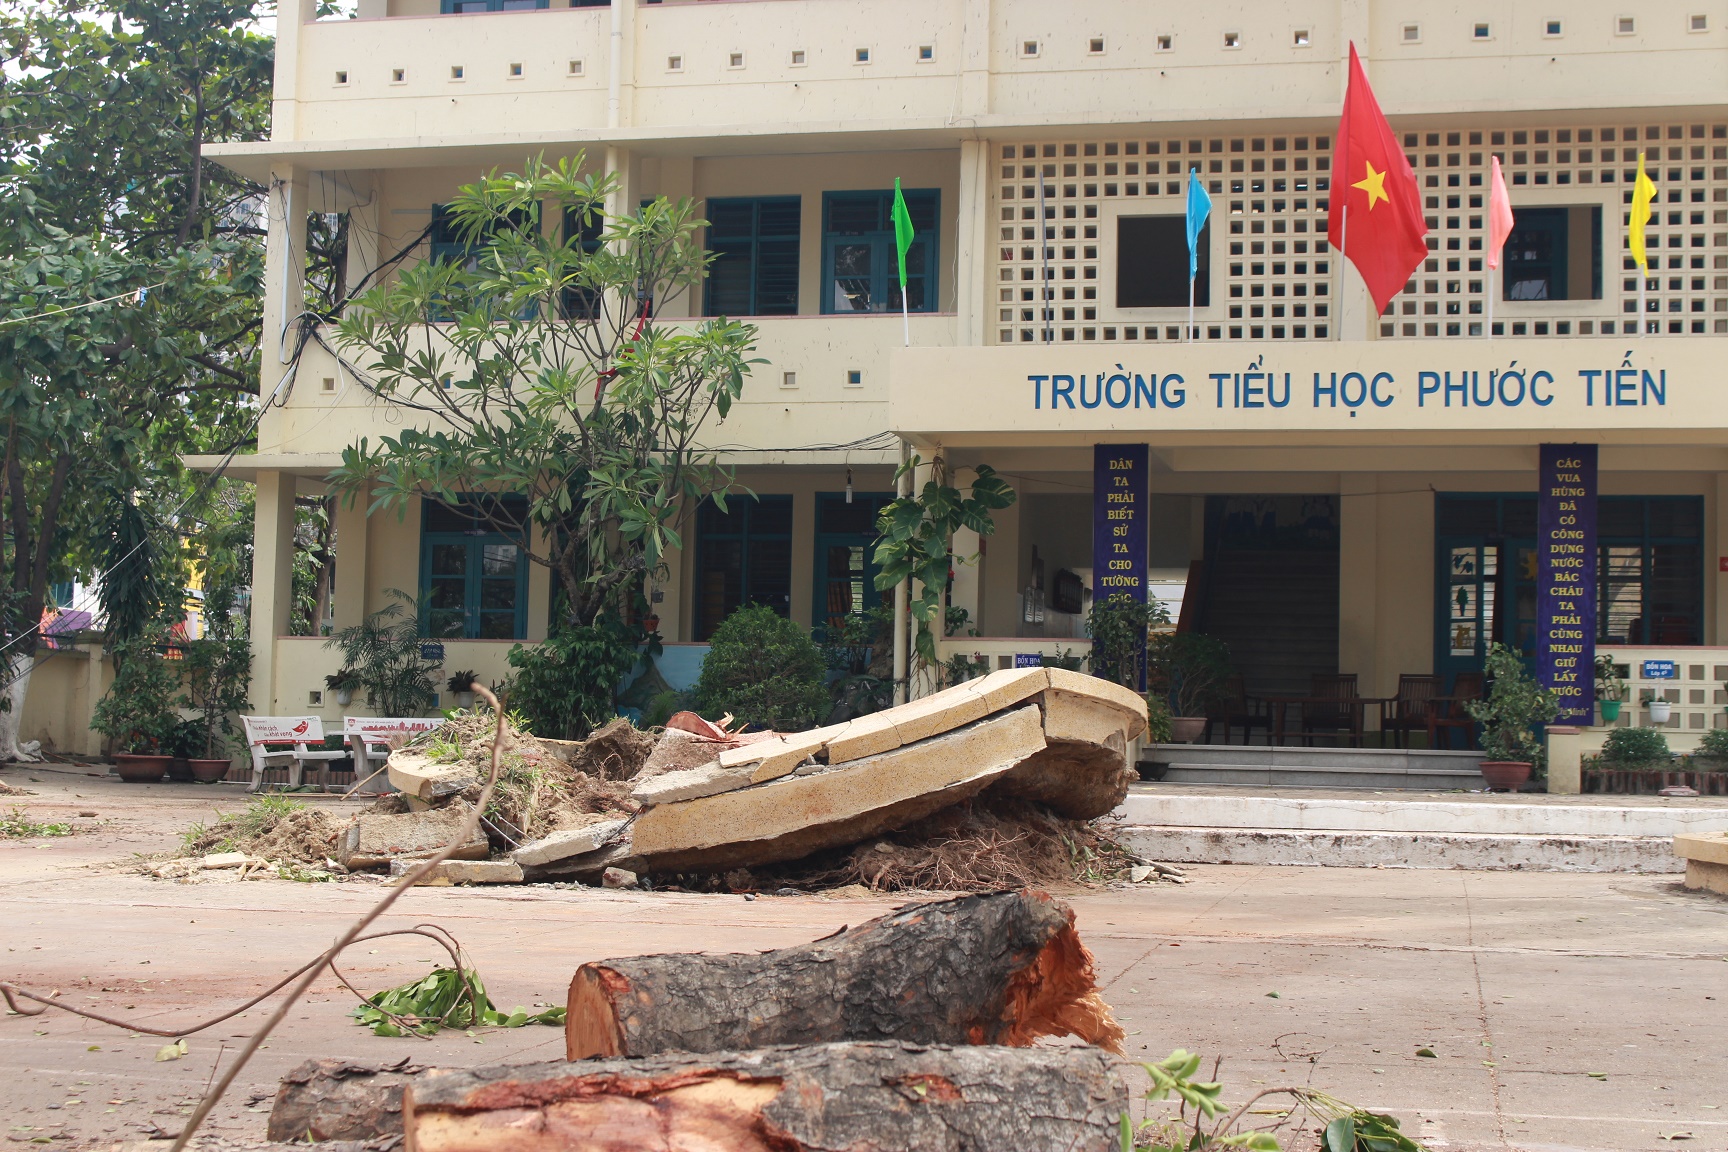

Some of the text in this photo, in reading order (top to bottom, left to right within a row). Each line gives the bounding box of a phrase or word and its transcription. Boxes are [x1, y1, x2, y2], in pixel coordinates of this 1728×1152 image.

[1028, 350, 1666, 417] TRƯỜNG TIỂU HỌC PHƯỚC TIẾN
[1109, 458, 1133, 470] DÂN
[1556, 458, 1581, 468] CÁC
[1113, 477, 1129, 486] TA
[1556, 474, 1581, 482] VUA
[1551, 486, 1585, 496] HÙNG
[1107, 490, 1135, 503] PHẢI
[1559, 501, 1577, 511] ĐÃ
[1107, 506, 1134, 519] BIẾT
[1559, 515, 1576, 525] CÓ
[1113, 523, 1129, 537] SỬ
[1551, 529, 1584, 539] CÔNG
[1113, 544, 1129, 553] TA
[1550, 544, 1585, 555] DỰNG
[1108, 560, 1132, 570] CHO
[1550, 557, 1584, 567] NƯỚC
[1101, 575, 1139, 587] TƯỜNG
[1554, 571, 1579, 582] BÁC
[1549, 586, 1584, 596] CHÁU
[1558, 601, 1575, 610] TA
[1551, 613, 1581, 625] PHẢI
[1549, 628, 1583, 639] CÙNG
[1549, 644, 1582, 653] NHAU
[1555, 658, 1577, 667] GIỮ
[1553, 670, 1577, 682] LẤY
